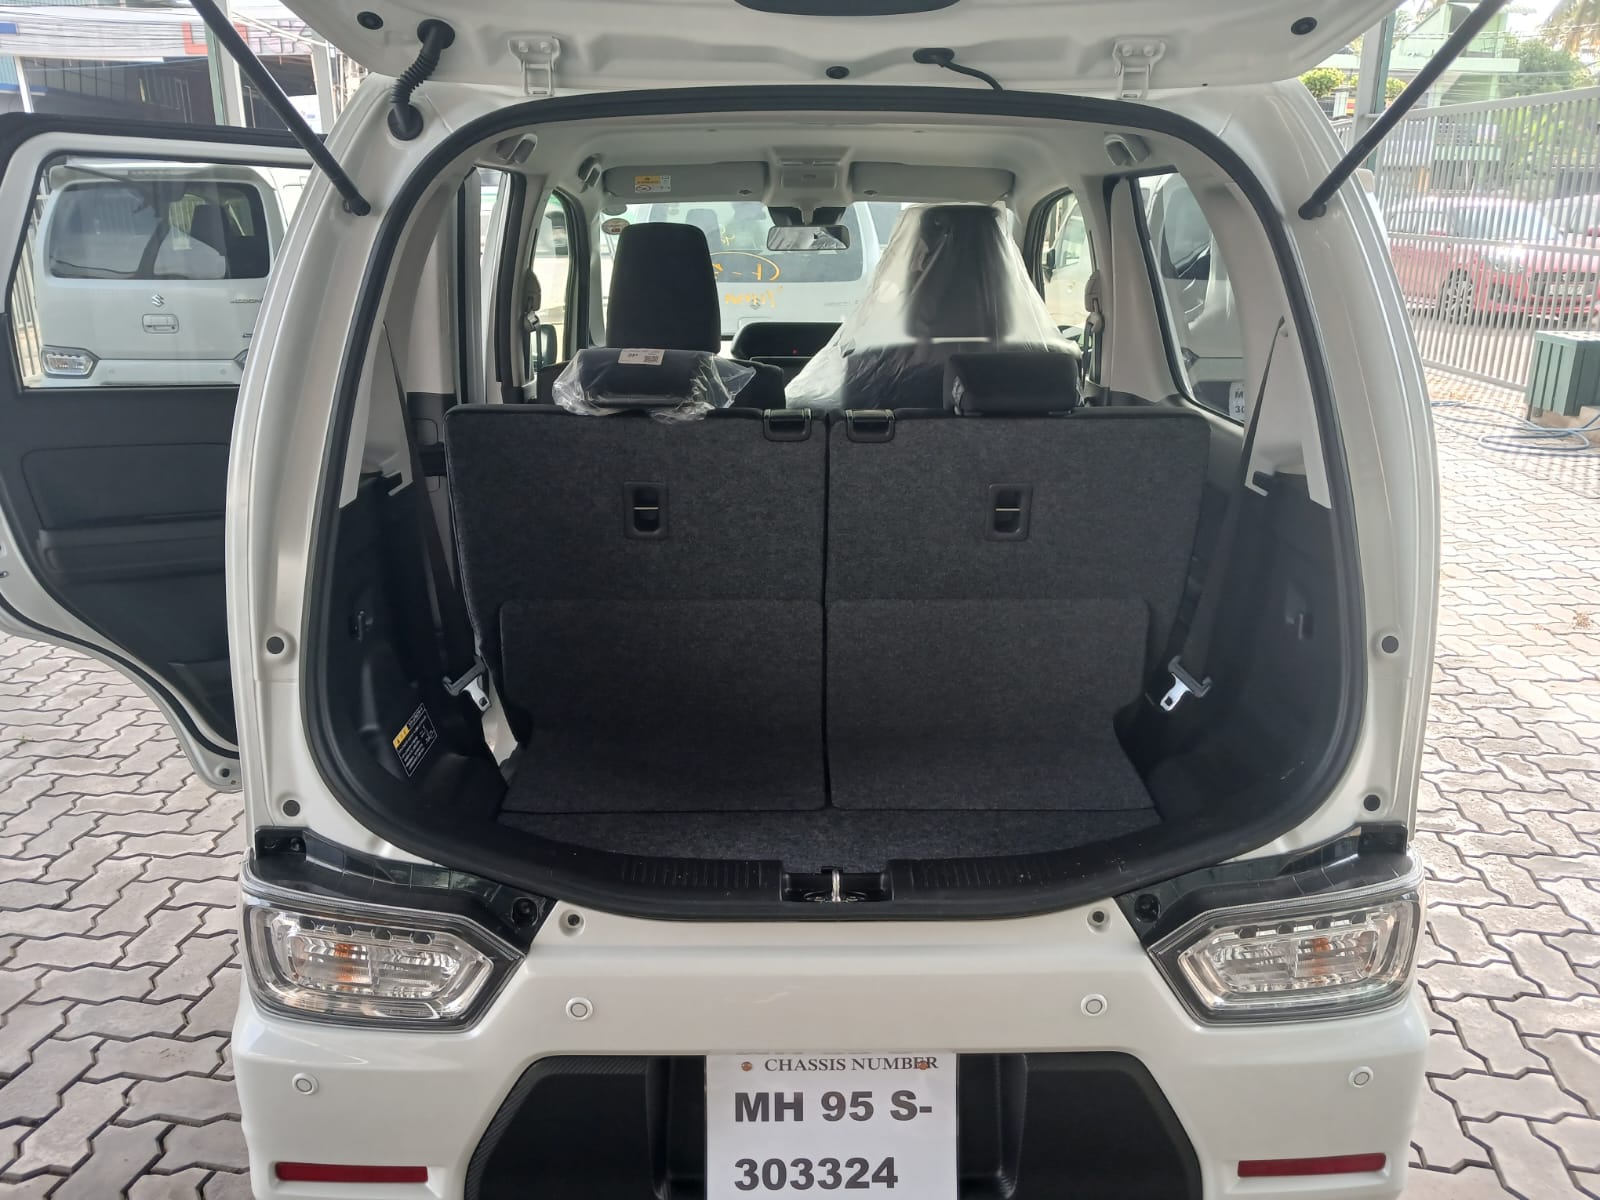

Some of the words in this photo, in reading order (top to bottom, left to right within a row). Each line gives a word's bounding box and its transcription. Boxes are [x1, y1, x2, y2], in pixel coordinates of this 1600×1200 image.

[764, 1058, 846, 1072] CHASSIS
[851, 1056, 939, 1071] NUMBER
[734, 1091, 804, 1123] MH
[820, 1090, 875, 1122] 95
[889, 1089, 933, 1122] S-
[734, 1156, 899, 1191] 303324
